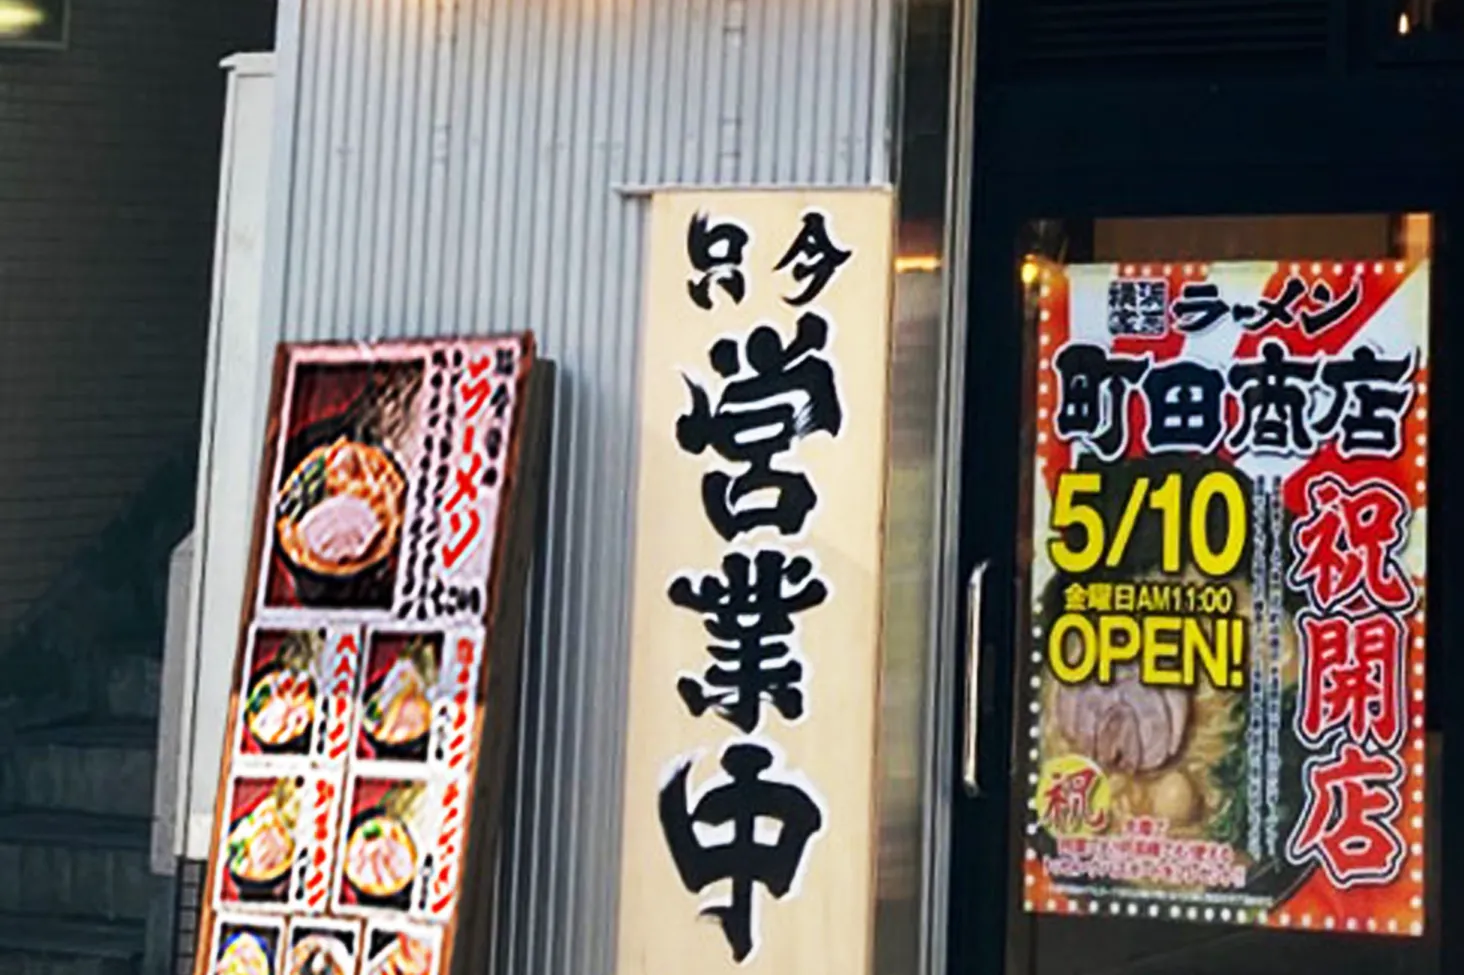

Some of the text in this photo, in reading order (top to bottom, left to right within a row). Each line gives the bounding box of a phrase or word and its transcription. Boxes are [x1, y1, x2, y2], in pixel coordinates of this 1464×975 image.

[1172, 278, 1362, 334] ラーメン
[1055, 342, 1418, 461] 町田商店
[442, 355, 491, 568] ラーメン
[1050, 471, 1248, 576] 5/10
[657, 312, 844, 965] 営業中
[1049, 613, 1245, 687] OPEN!
[1290, 474, 1414, 886] 祝開店
